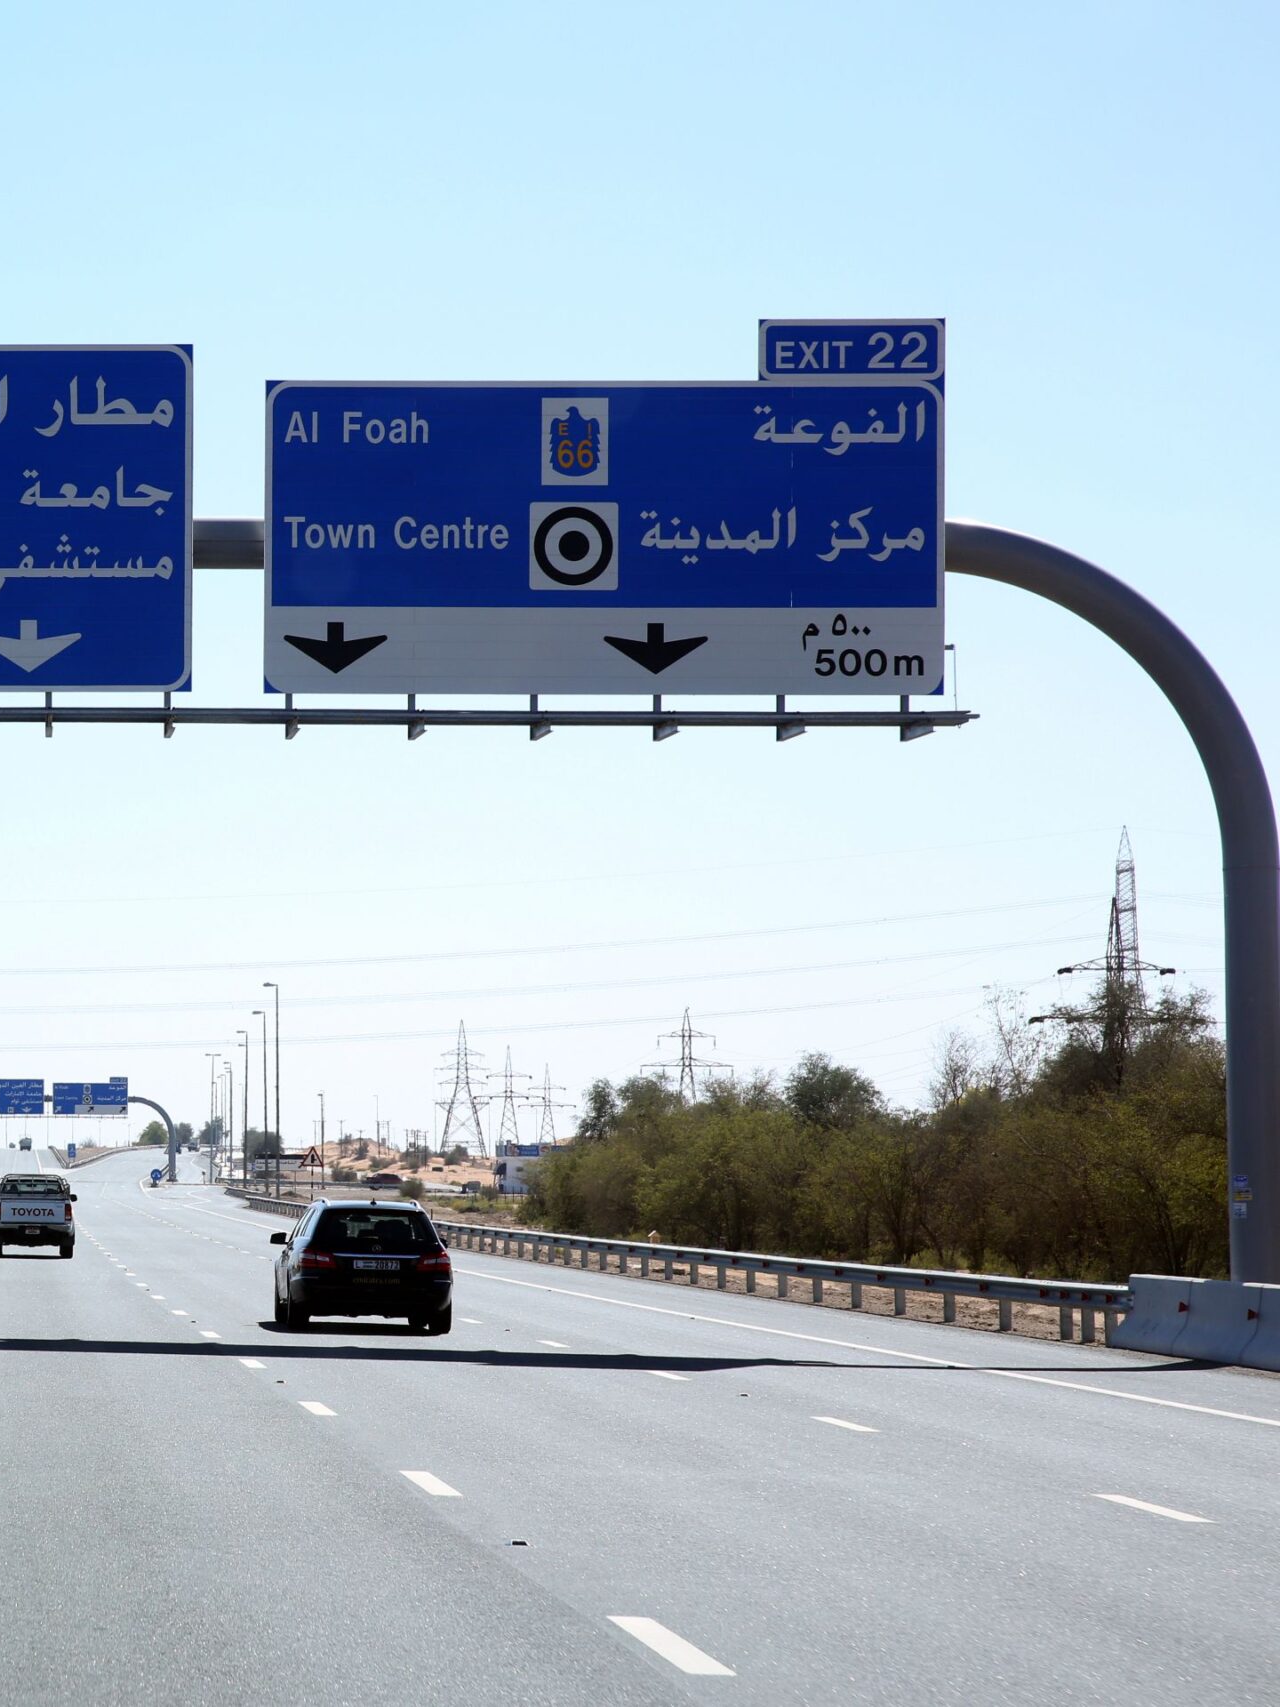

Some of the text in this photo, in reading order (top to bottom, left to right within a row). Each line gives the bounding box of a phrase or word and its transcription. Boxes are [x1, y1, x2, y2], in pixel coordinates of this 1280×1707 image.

[776, 331, 929, 370] EXIT 22
[34, 375, 174, 438] مطار
[284, 411, 429, 444] Al Foah
[558, 422, 569, 436] E
[753, 400, 926, 456] الفوعة
[557, 439, 594, 469] 66
[20, 465, 173, 516] جامعة
[283, 516, 509, 550] Town Centre
[639, 506, 925, 564] مركز المدينة
[10, 1207, 55, 1217] TOYOTA
